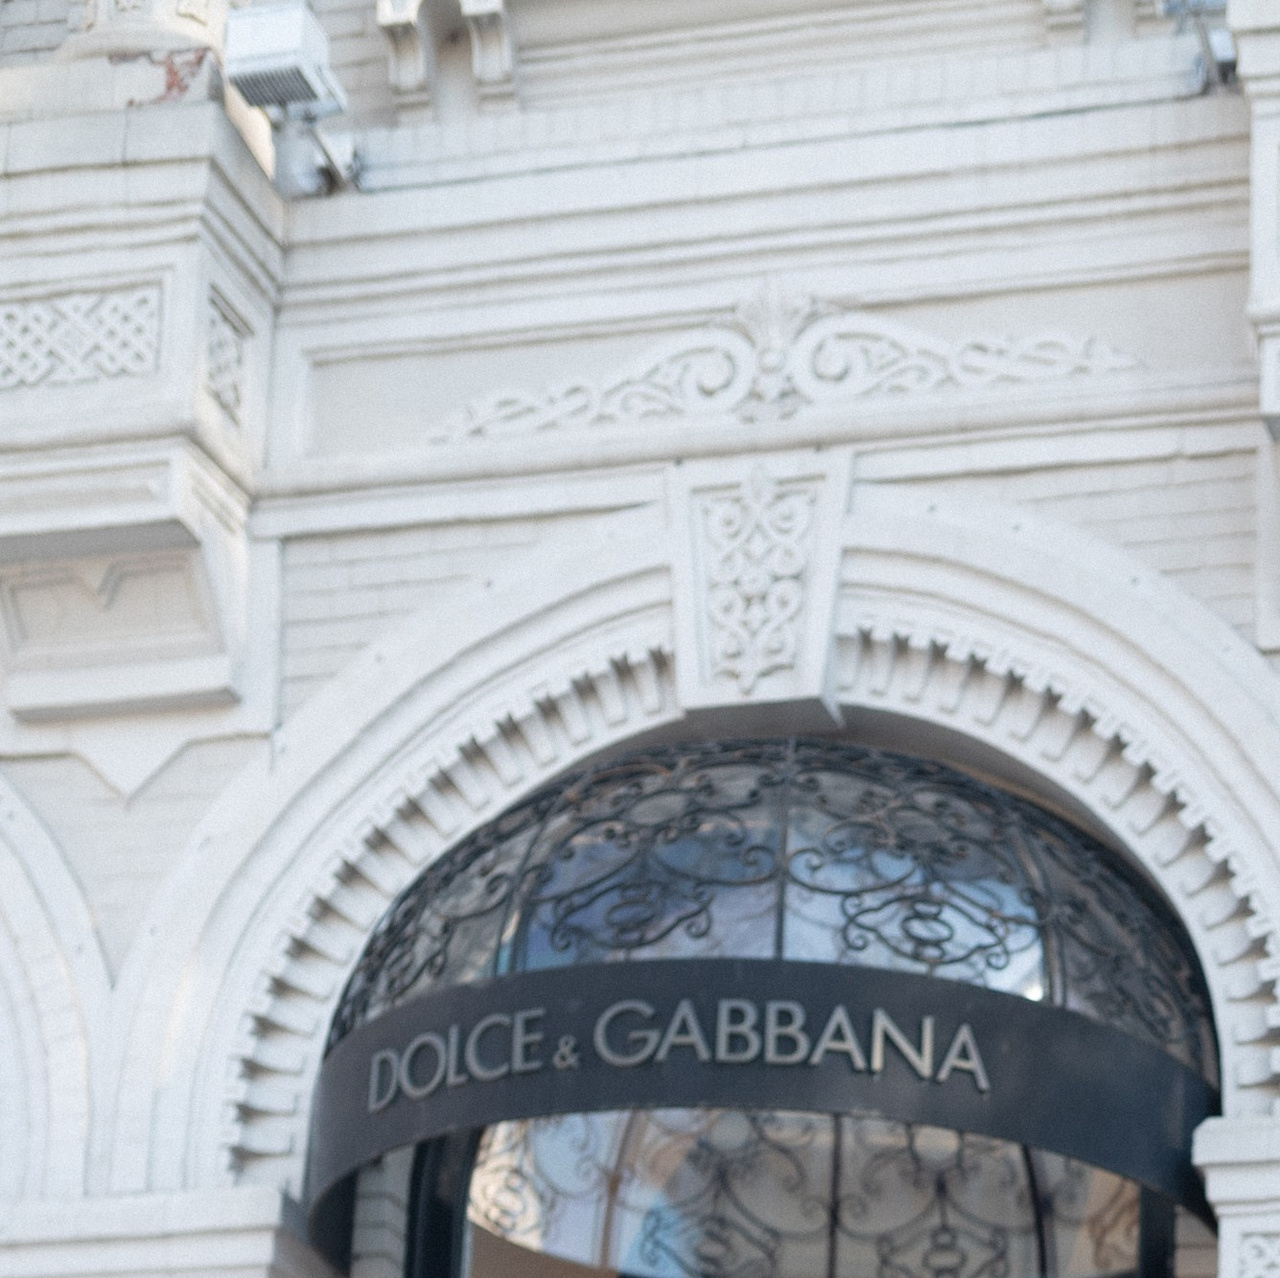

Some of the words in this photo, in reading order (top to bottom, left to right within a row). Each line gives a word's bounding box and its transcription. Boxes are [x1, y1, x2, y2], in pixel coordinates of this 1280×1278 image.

[368, 1006, 547, 1114] DOLCE
[553, 1034, 580, 1070] &
[593, 999, 992, 1093] GABBANA
